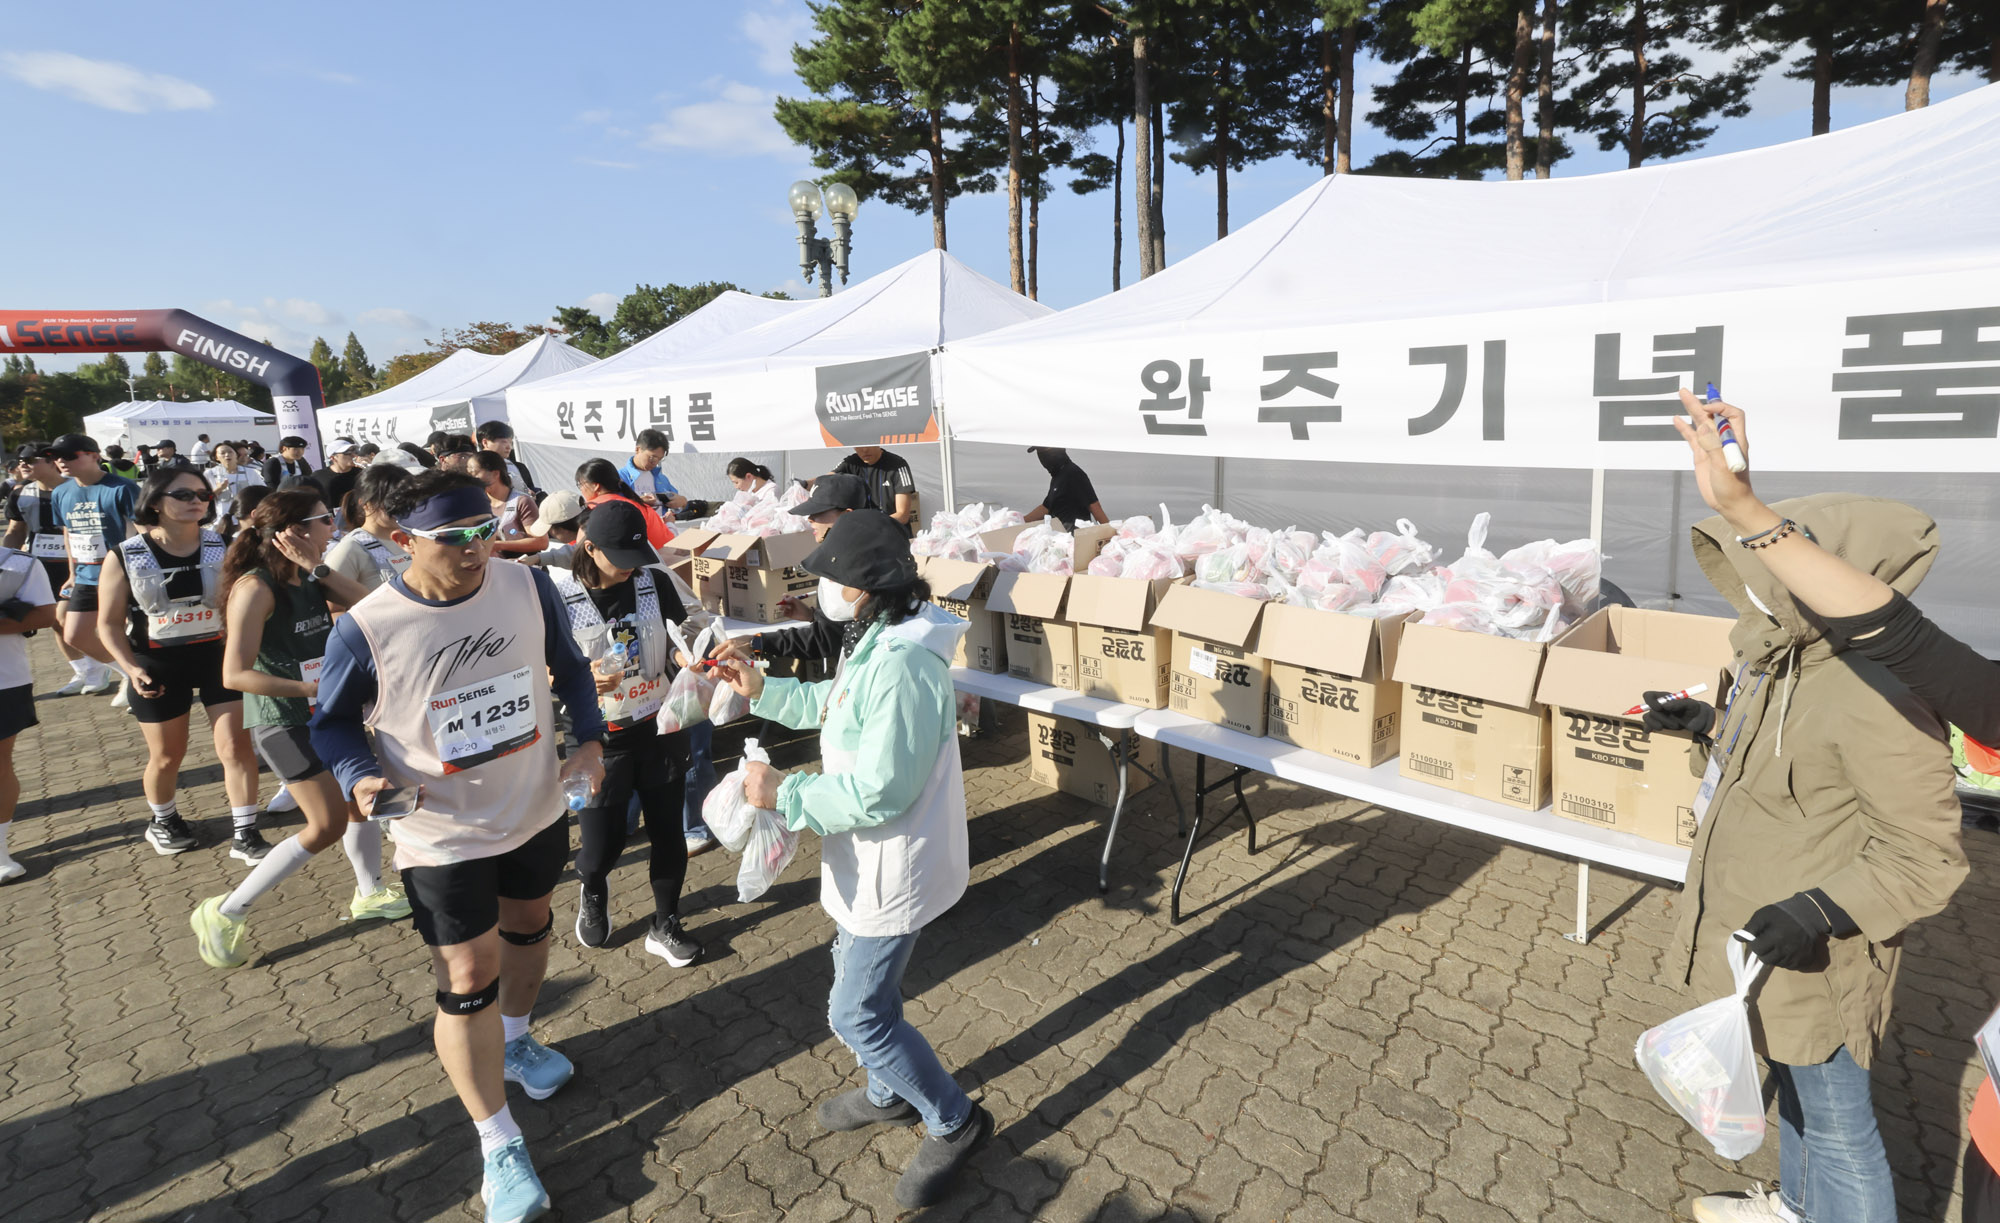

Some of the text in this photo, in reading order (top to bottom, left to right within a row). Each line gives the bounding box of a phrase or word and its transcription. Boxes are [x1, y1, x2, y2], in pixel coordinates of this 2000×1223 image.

[176, 329, 270, 377] FINISH
[172, 610, 213, 625] 6319
[1215, 660, 1251, 687] 꼬깔
[1174, 684, 1192, 695] 12 SET
[1187, 678, 1193, 686] 6
[431, 685, 496, 711] Run SENSE
[1301, 678, 1360, 712] 꼬깔콘
[447, 694, 530, 733] M 1235
[1288, 702, 1294, 711] 6
[1286, 711, 1293, 720] 12
[1435, 717, 1463, 730] KBO 기획
[1564, 711, 1651, 754] 꼬깔콘
[451, 742, 478, 755] A-20
[1410, 752, 1453, 768] 511003192
[1591, 752, 1626, 767] KBO 기획
[1562, 792, 1614, 811] 511003192
